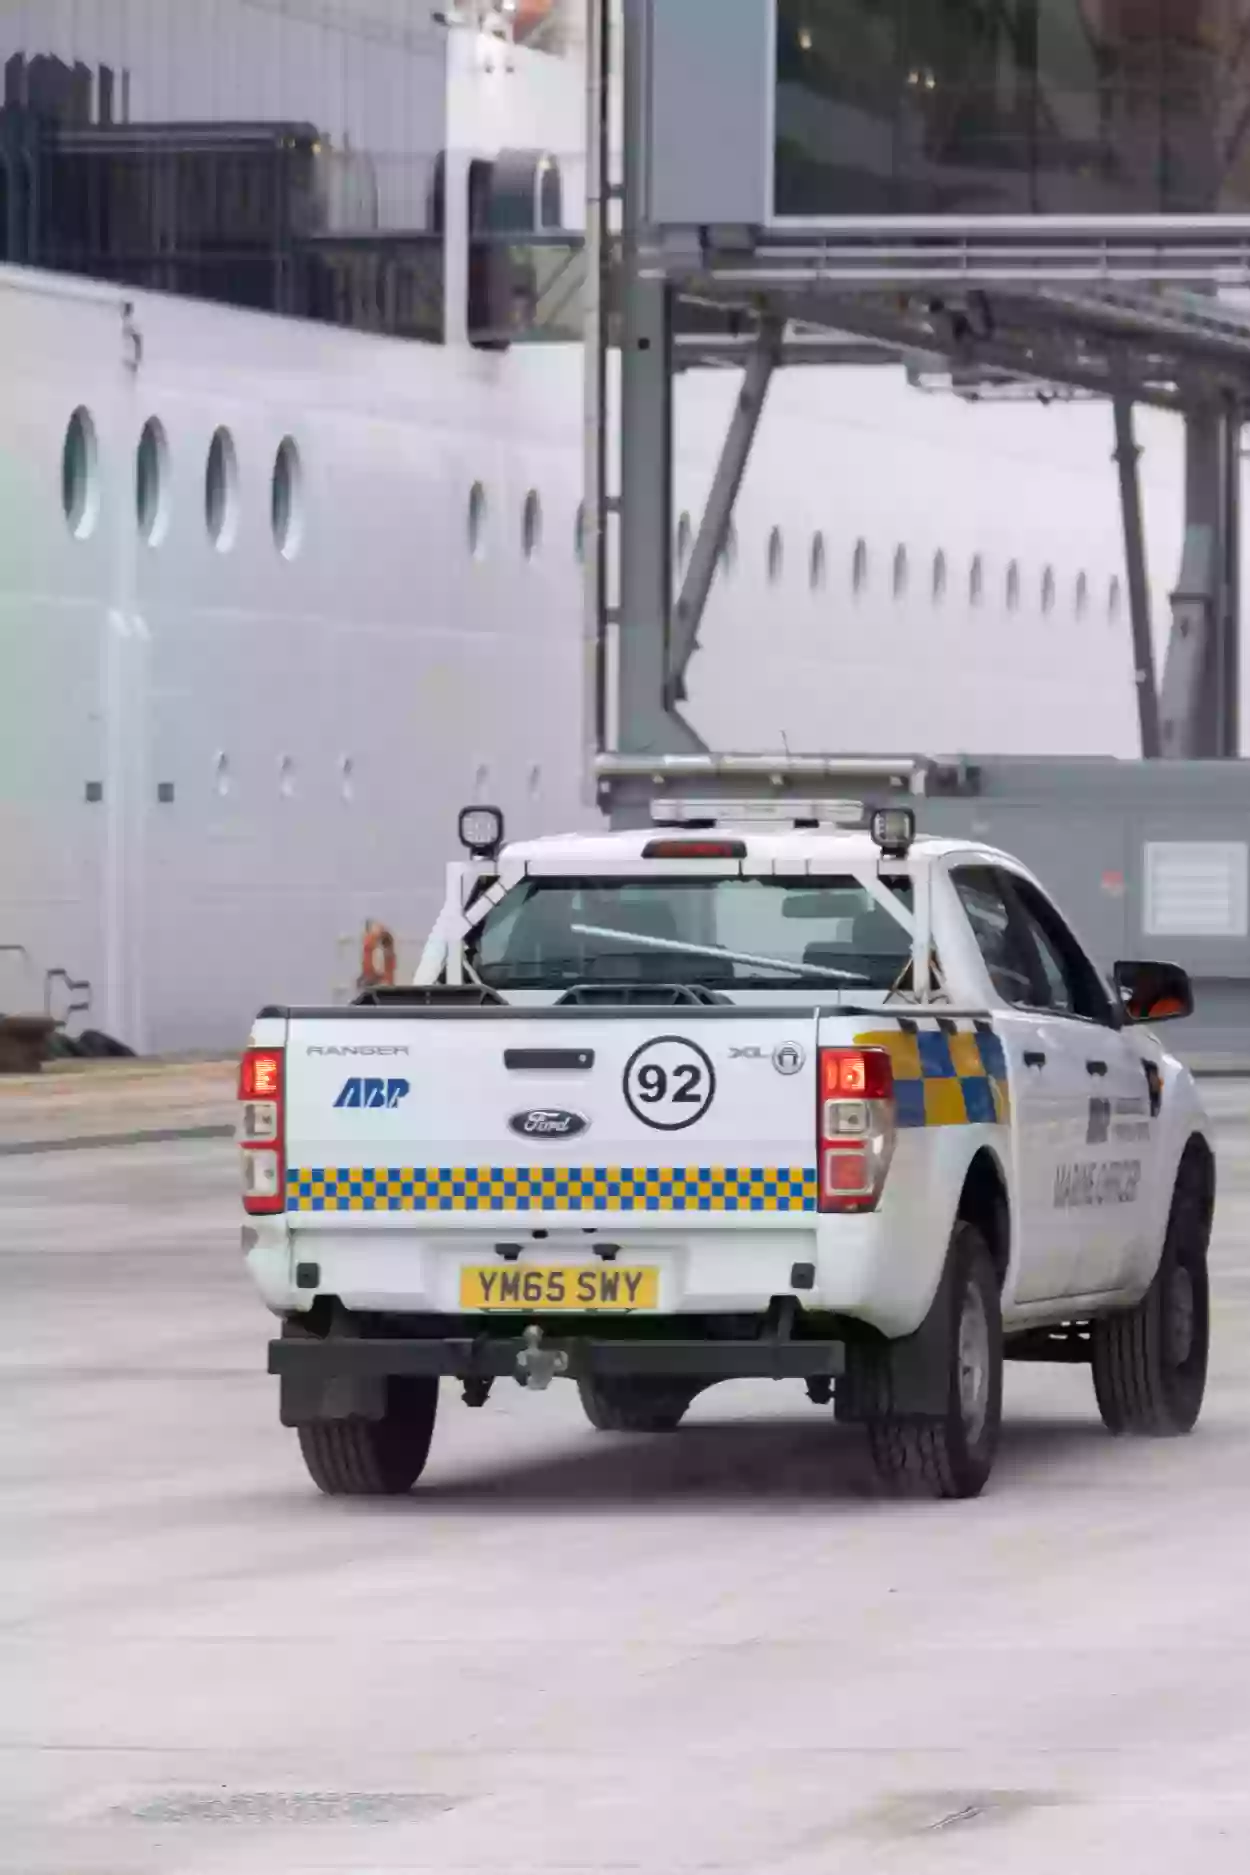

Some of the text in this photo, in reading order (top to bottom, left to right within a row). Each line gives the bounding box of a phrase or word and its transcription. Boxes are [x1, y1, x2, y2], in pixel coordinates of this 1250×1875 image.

[305, 1045, 410, 1057] RANGER
[728, 1046, 772, 1059] XL
[332, 1077, 411, 1109] ABP
[637, 1063, 703, 1103] 92
[523, 1111, 571, 1133] Ford
[478, 1270, 643, 1302] YM65 SWY
